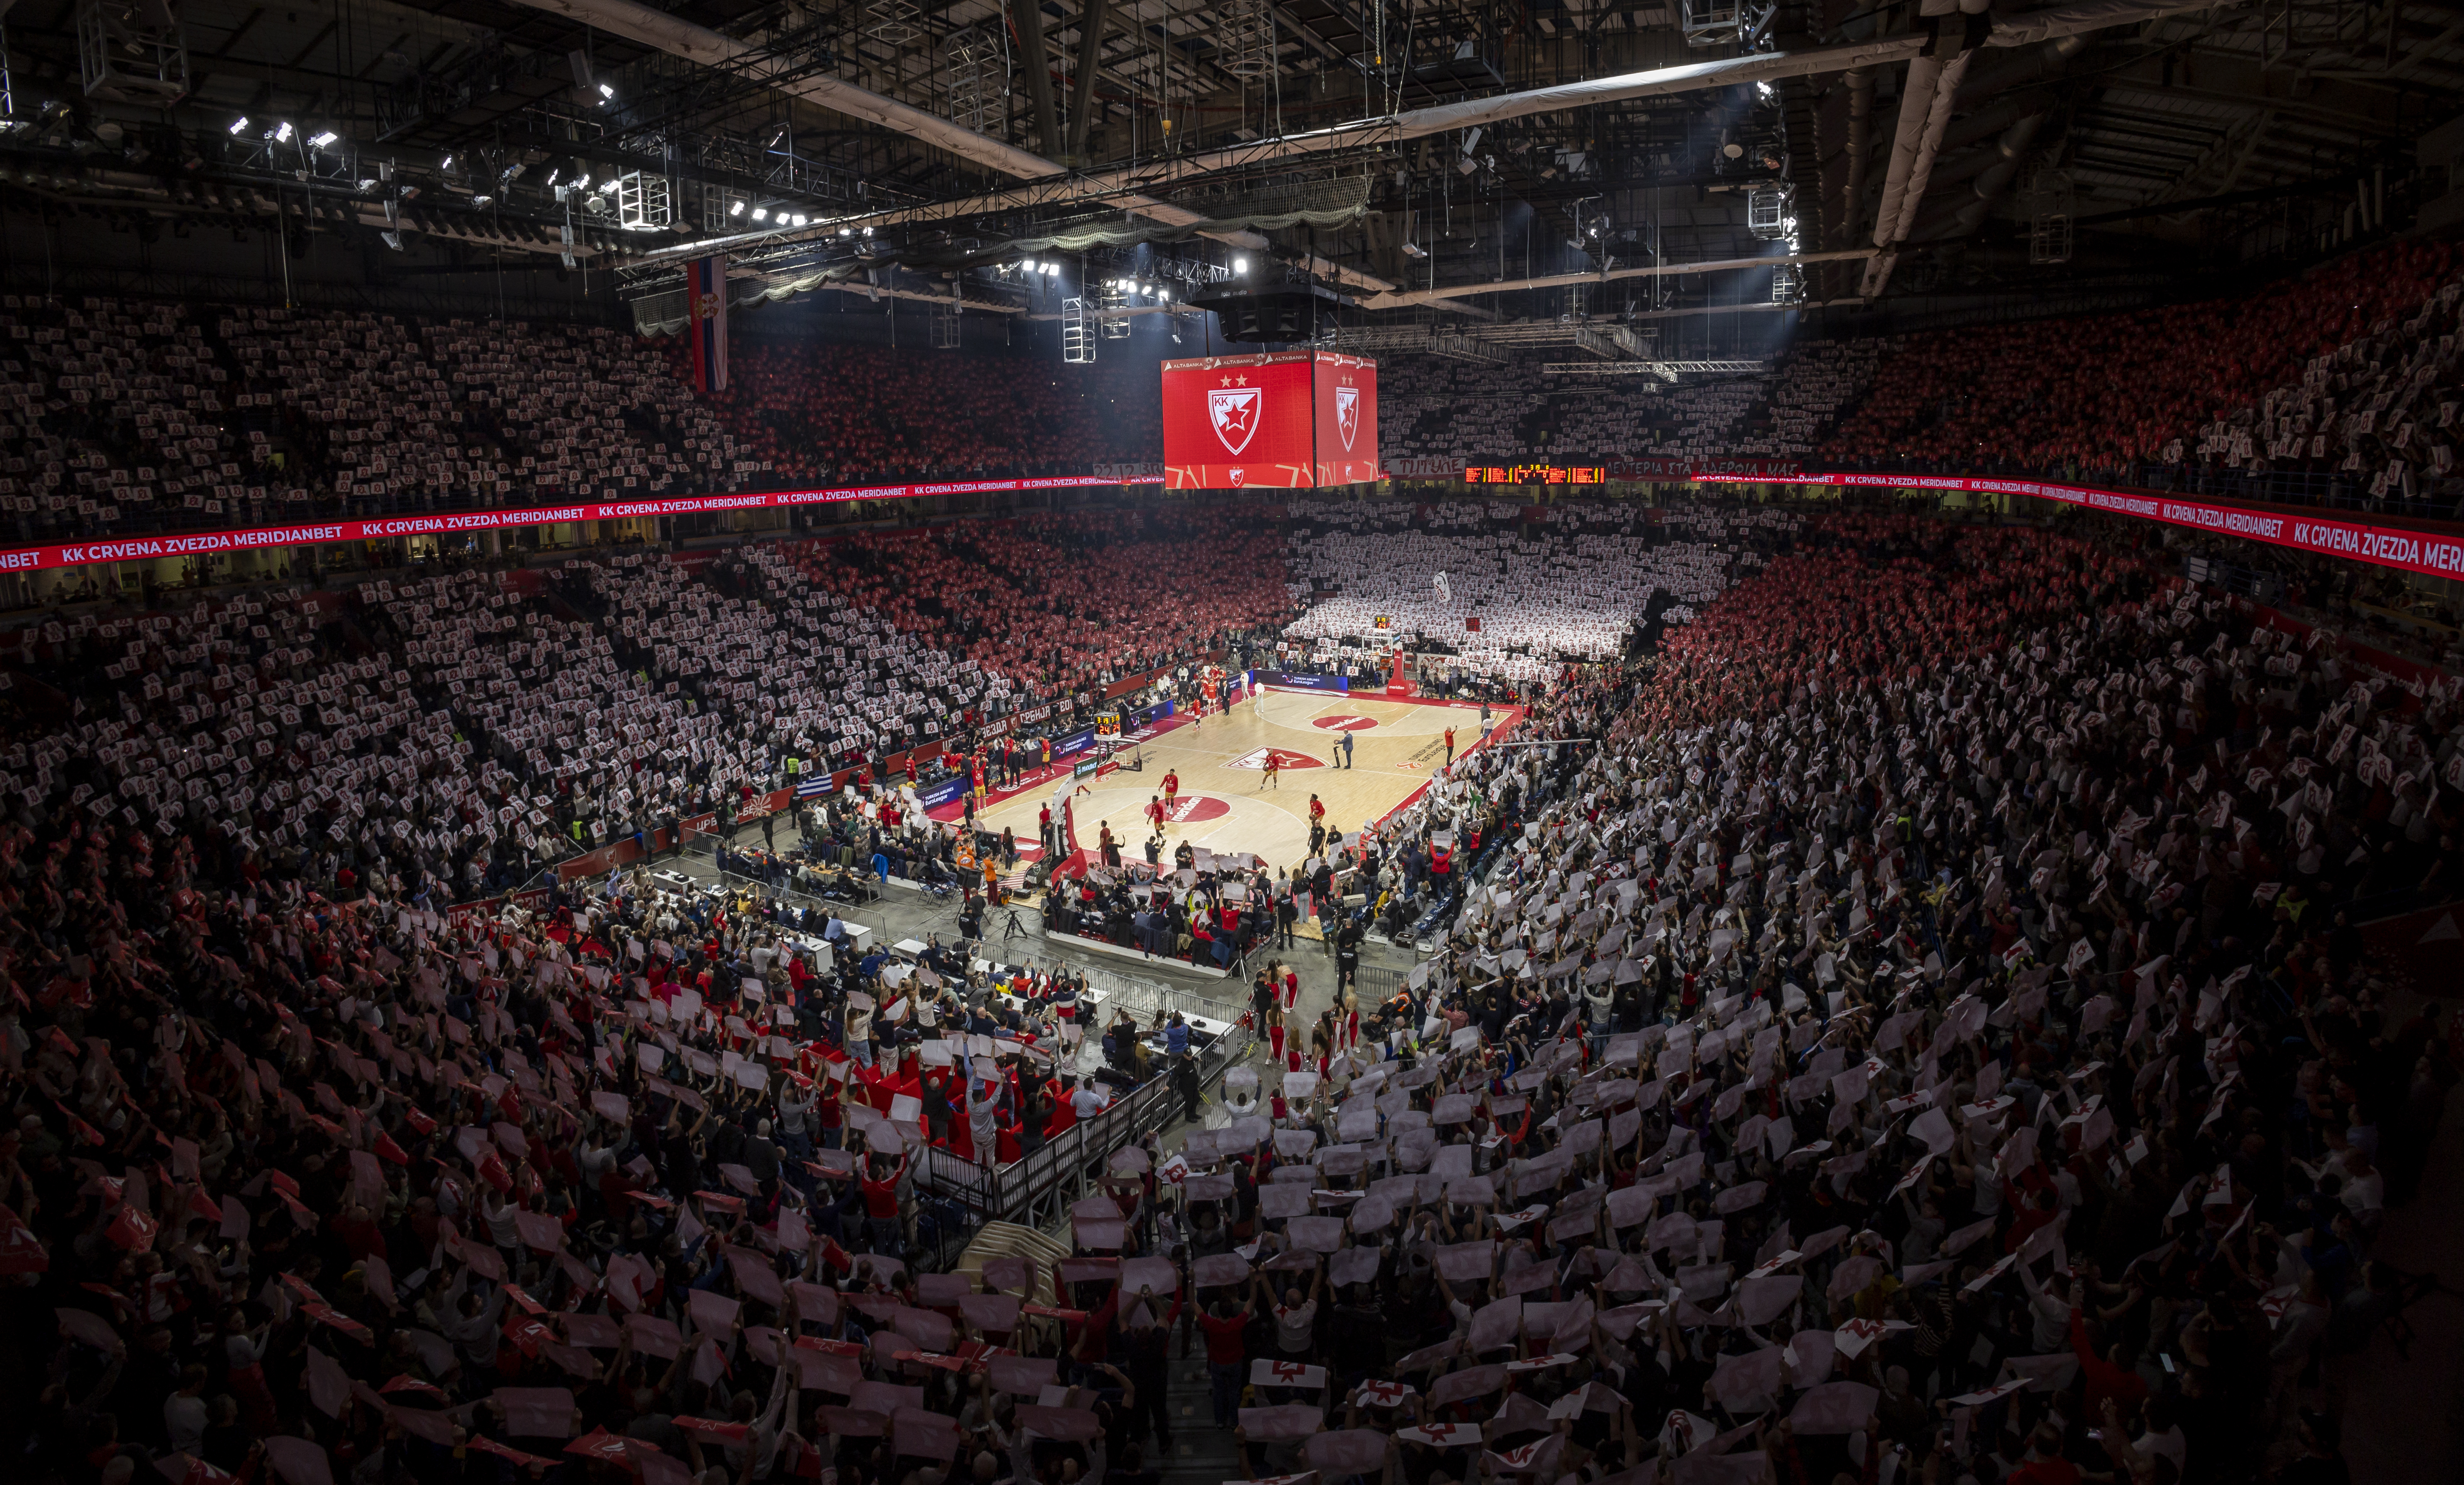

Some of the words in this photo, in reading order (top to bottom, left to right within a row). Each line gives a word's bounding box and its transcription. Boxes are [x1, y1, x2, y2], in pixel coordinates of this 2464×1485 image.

[1215, 397, 1229, 407] KK
[1339, 395, 1345, 404] KK
[925, 485, 951, 493] CRVENA
[953, 484, 977, 492] ZVEZDA
[978, 482, 1016, 491] MERIDIANBET
[1888, 478, 1918, 486] ZVEZDA
[1920, 479, 1963, 488] MERIDIANBET
[1982, 481, 2000, 491] CRVENA
[2002, 483, 2021, 492] ZVEZDA
[777, 494, 789, 503] KK
[791, 493, 824, 503] CRVENA
[826, 491, 856, 500] ZVEZDA
[858, 488, 907, 498] MERIDIANBET
[599, 506, 614, 516] KK
[617, 503, 660, 515] CRVENA
[662, 500, 702, 512] ZVEZDA
[704, 496, 766, 509] MERIDIANBET
[2089, 493, 2094, 504] KK
[2094, 494, 2109, 507] CRVENA
[2109, 496, 2125, 510] ZVEZDA
[2126, 498, 2158, 516] MERIDIANBET
[363, 523, 383, 535] KK
[387, 518, 444, 533] CRVENA
[447, 514, 499, 528] ZVEZDA
[503, 508, 584, 524] MERIDIANBET
[2163, 503, 2171, 518] KK
[2171, 507, 2195, 523] CRVENA
[2197, 508, 2224, 529] ZVEZDA
[2225, 513, 2283, 539] MERIDIANBET
[63, 548, 85, 562] KK
[89, 541, 162, 559] CRVENA
[166, 535, 231, 552] ZVEZDA
[235, 526, 343, 546] MERIDIANBET
[2294, 523, 2310, 544] KK
[2311, 525, 2359, 553] CRVENA
[2361, 533, 2419, 564] ZVEZDA
[1113, 724, 1120, 733] 24
[1325, 716, 1366, 730] meridian
[1100, 726, 1109, 735] 24
[1065, 743, 1082, 752] EuroLeague
[940, 787, 954, 797] AIRLINES
[925, 794, 948, 806] EuroLeague
[1171, 796, 1203, 822] meridian
